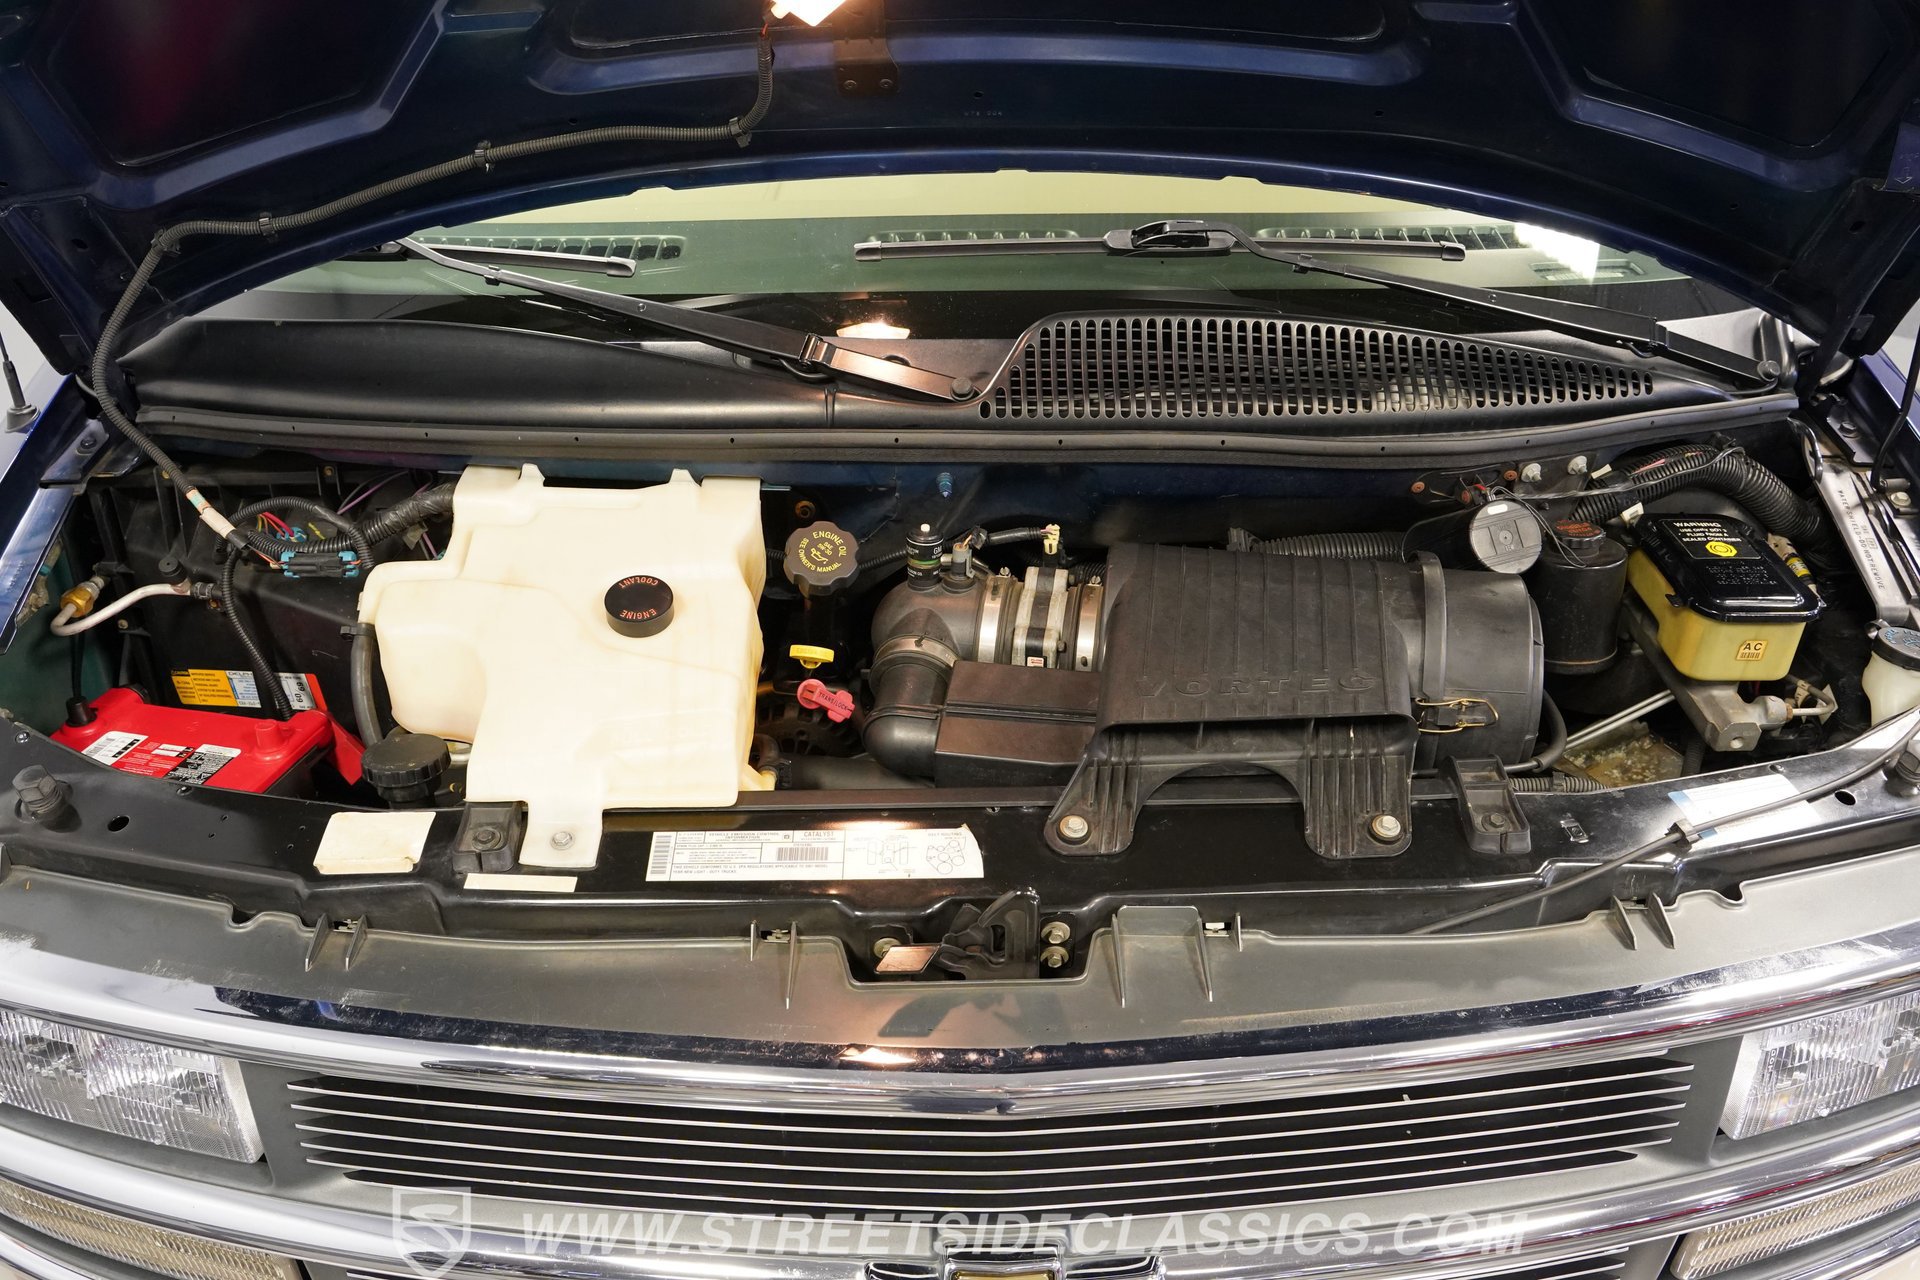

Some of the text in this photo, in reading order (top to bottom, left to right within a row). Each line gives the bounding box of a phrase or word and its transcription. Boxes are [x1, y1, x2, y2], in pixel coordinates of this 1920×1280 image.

[798, 537, 842, 573] SEE OWNER'S MANUAL
[812, 531, 847, 557] ENGINE OIL
[618, 576, 659, 589] COOLANT
[620, 608, 657, 620] ENGINE
[1136, 675, 1377, 697] VORTEC
[1768, 1049, 1776, 1072] DOT
